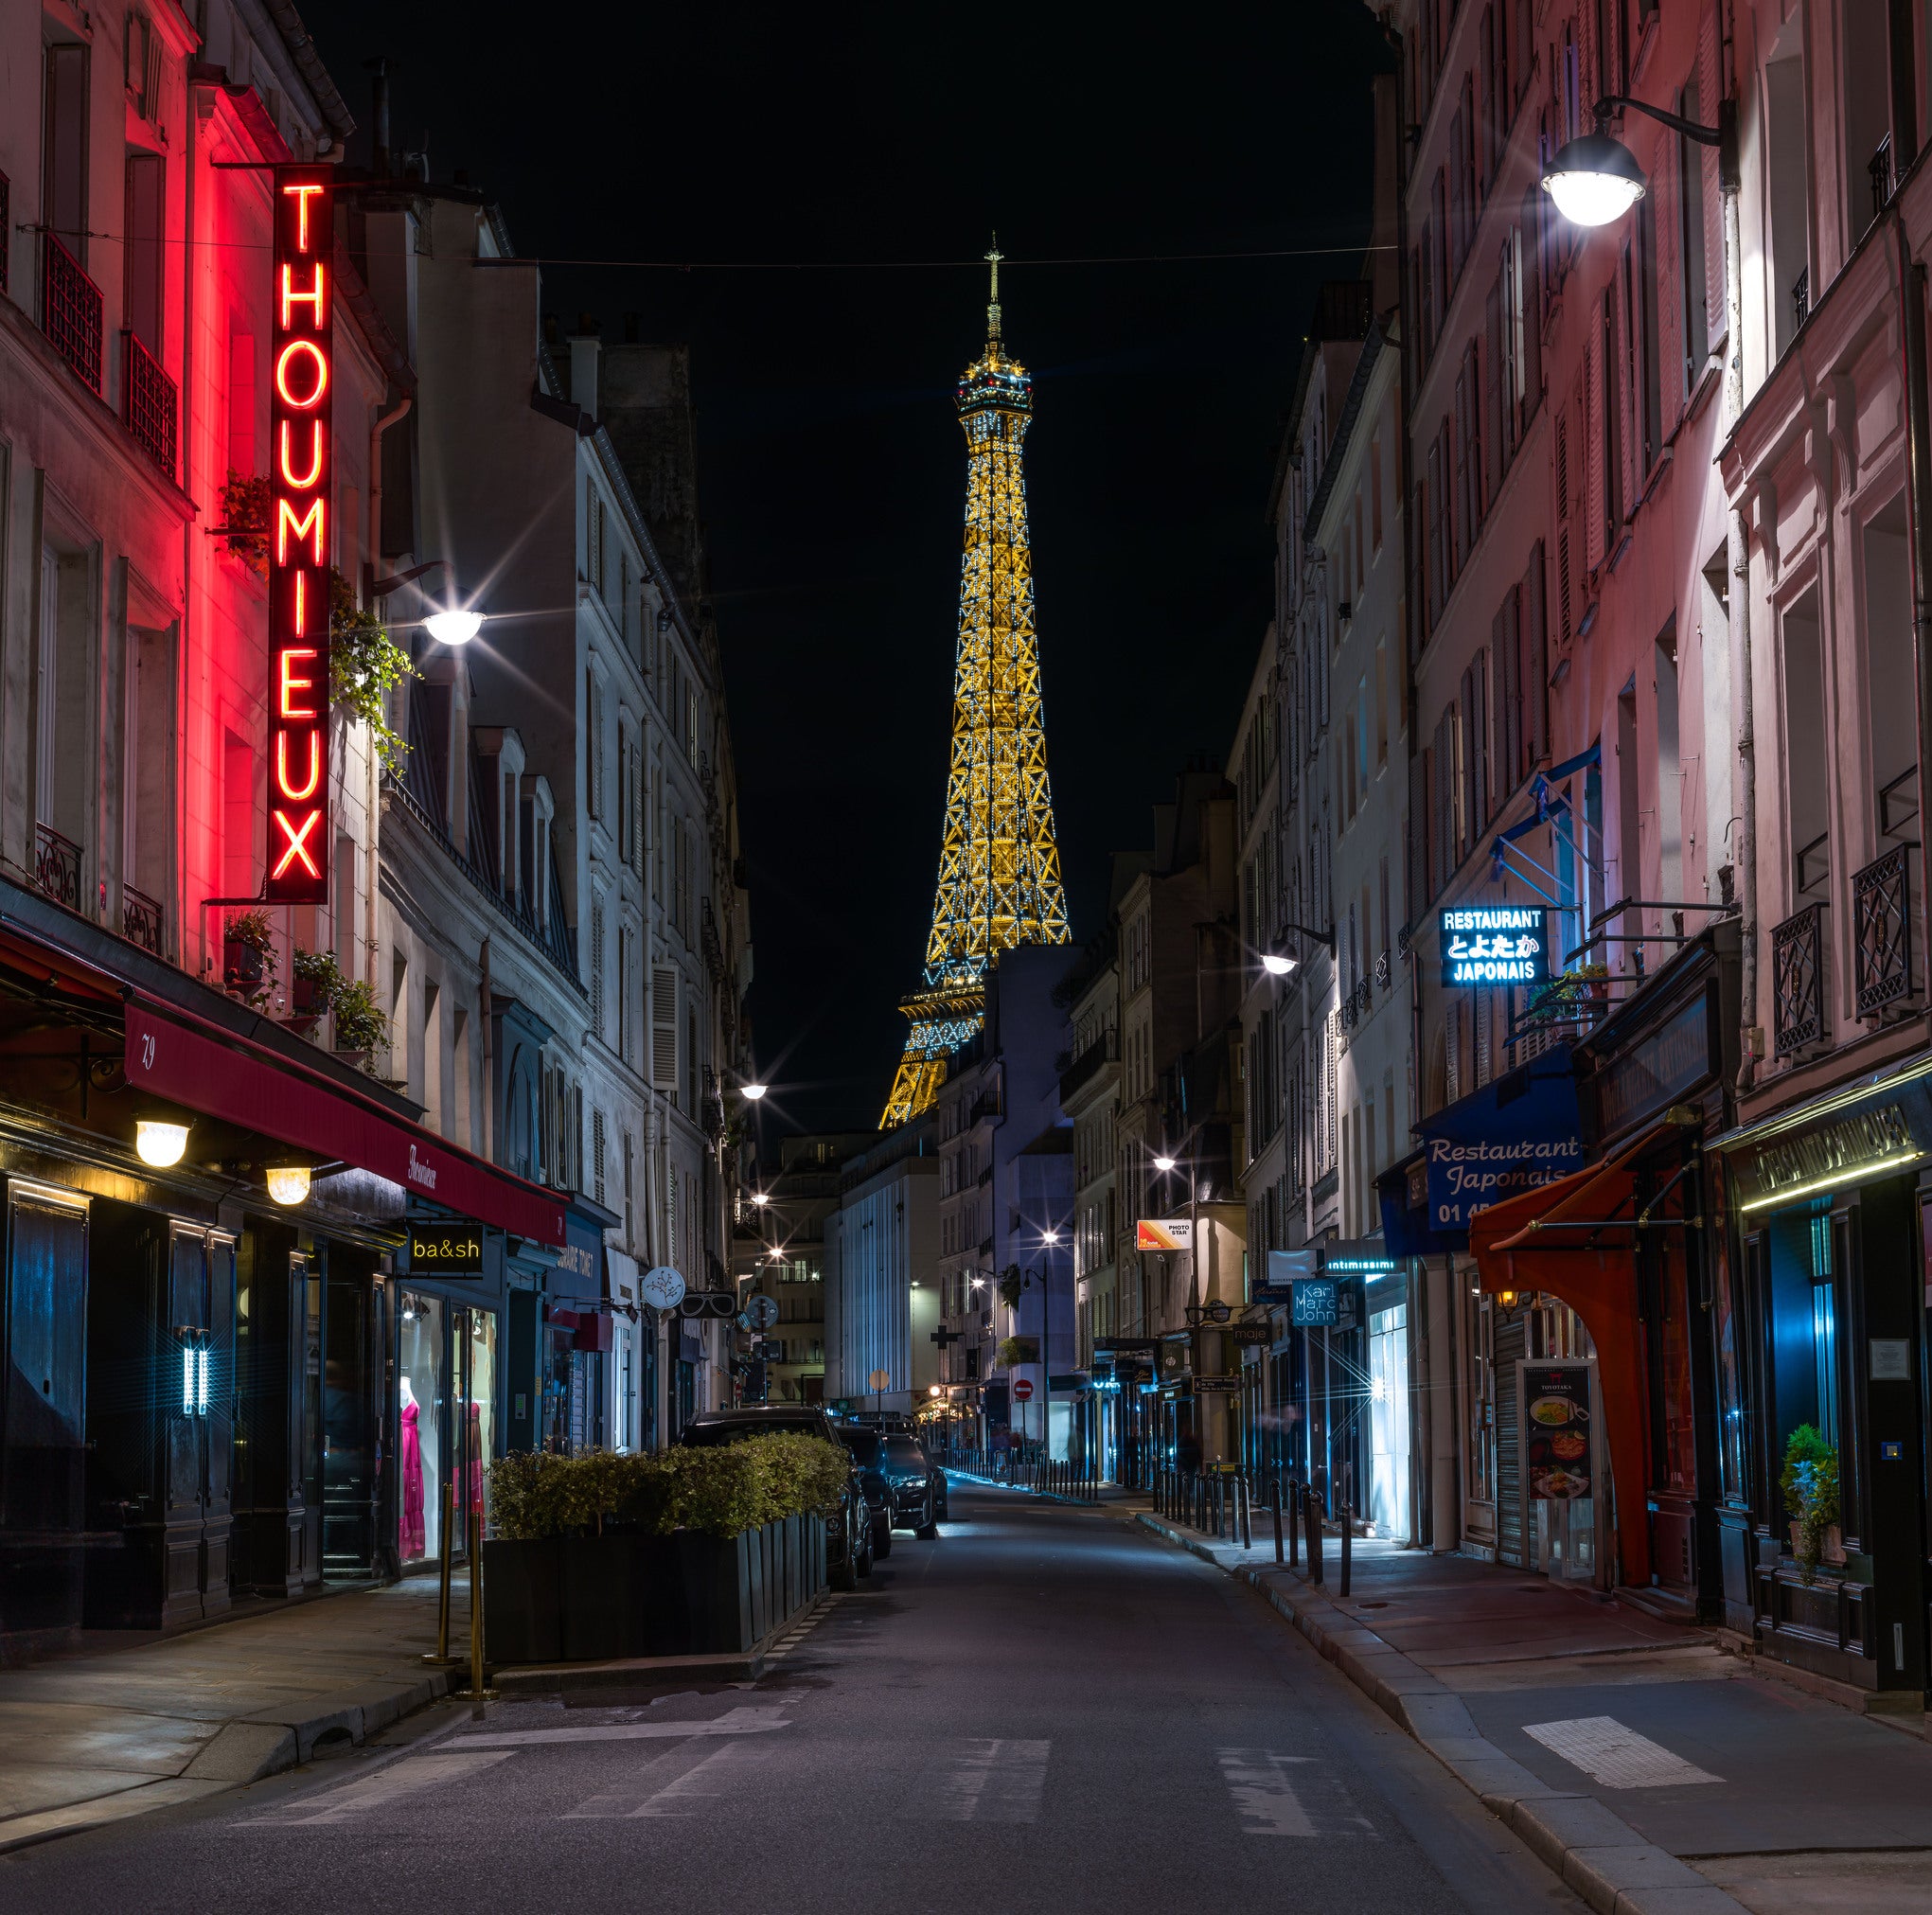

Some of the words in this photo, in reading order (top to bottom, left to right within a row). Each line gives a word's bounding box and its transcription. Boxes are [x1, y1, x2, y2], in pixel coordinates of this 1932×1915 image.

[272, 184, 328, 880] THOUMIEUX
[1445, 910, 1541, 930] RESTAURANT
[1447, 933, 1540, 959] とよたか
[1453, 960, 1535, 982] JAPONAIS
[141, 1033, 155, 1071] 79
[1428, 1136, 1579, 1163] Restaurant
[1445, 1164, 1568, 1196] Japonais
[1439, 1204, 1461, 1223] 01
[414, 1239, 479, 1258] ba&sh
[1328, 1260, 1394, 1269] intimissimi
[1303, 1285, 1337, 1298] Karl
[1296, 1296, 1337, 1309] Marc
[1296, 1307, 1337, 1321] John
[1234, 1328, 1267, 1340] maje
